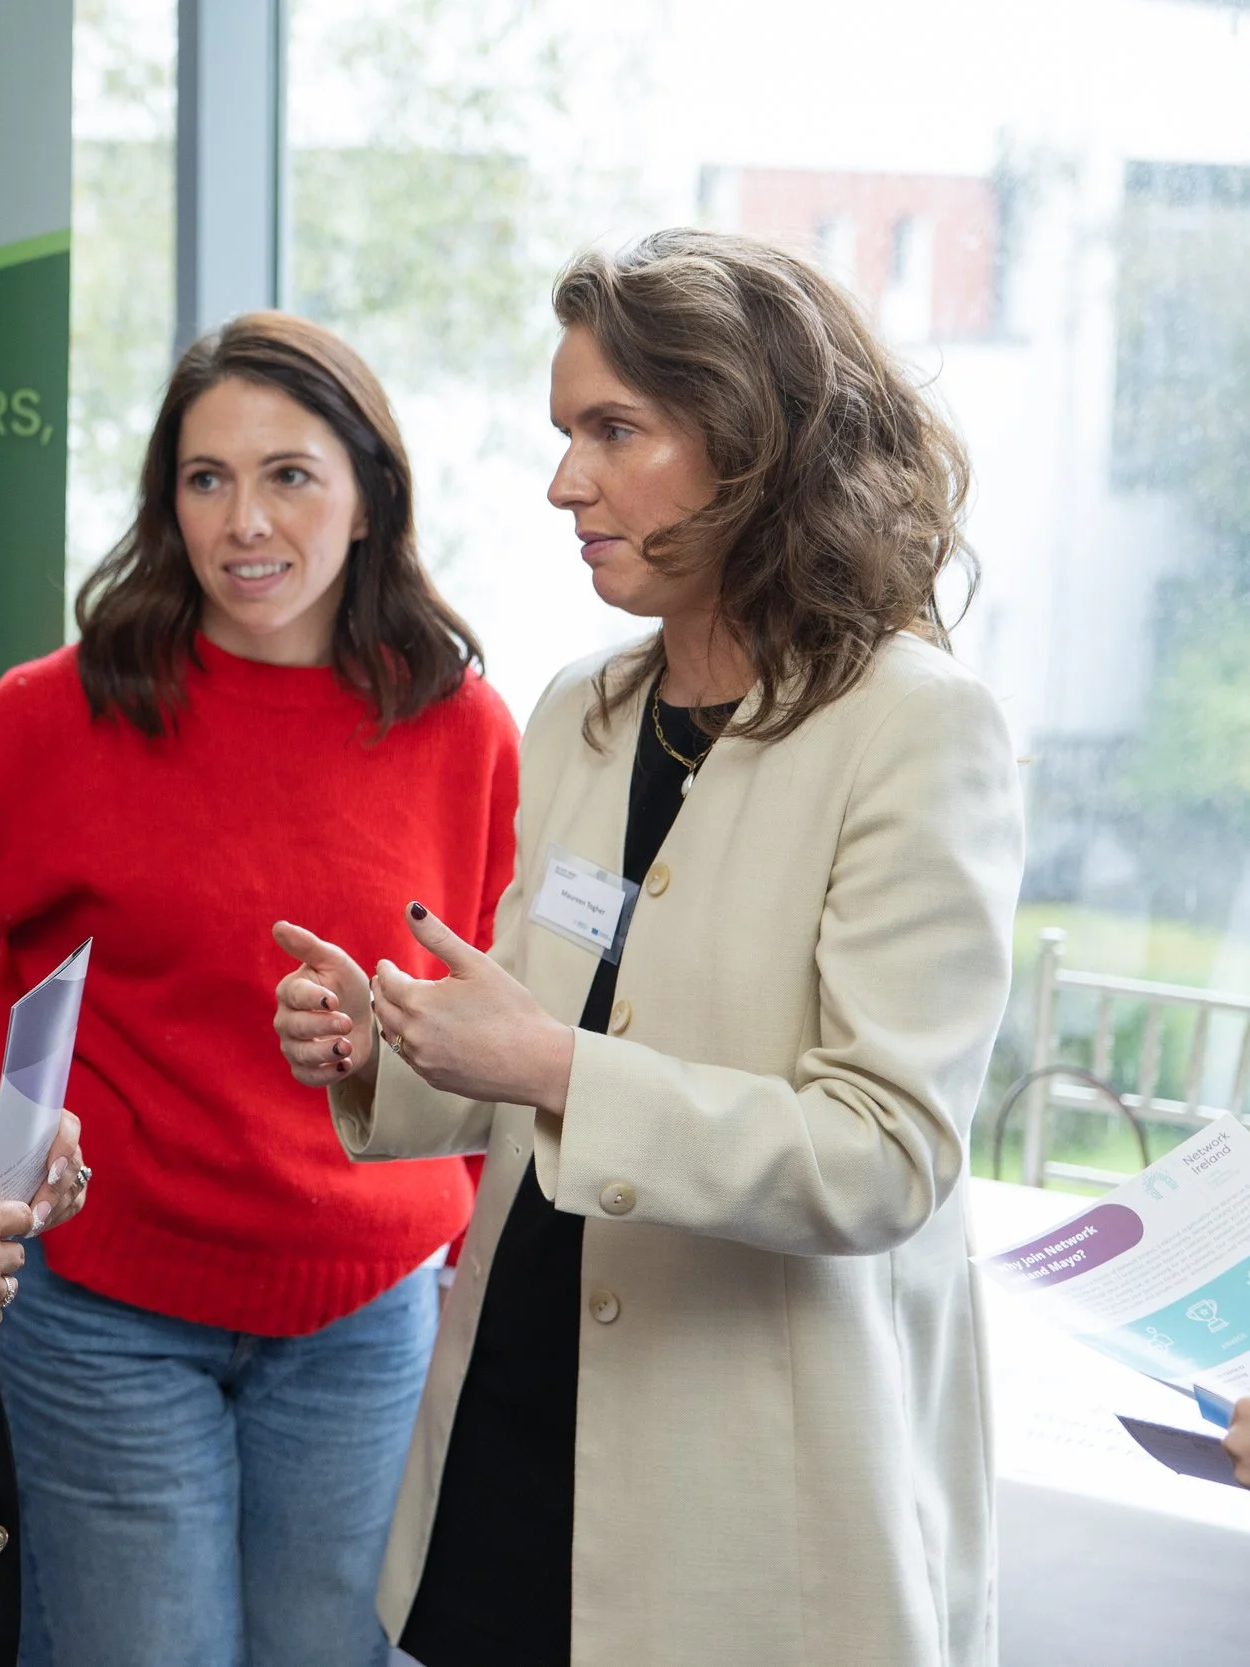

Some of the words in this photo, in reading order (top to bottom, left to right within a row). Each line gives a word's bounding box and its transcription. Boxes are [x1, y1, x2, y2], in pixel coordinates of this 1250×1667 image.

[1182, 1131, 1230, 1166] Network
[1191, 1144, 1231, 1175] Ireland
[1021, 1253, 1046, 1268] Join
[1044, 1224, 1098, 1257] Network
[1047, 1249, 1086, 1272] Mayo?
